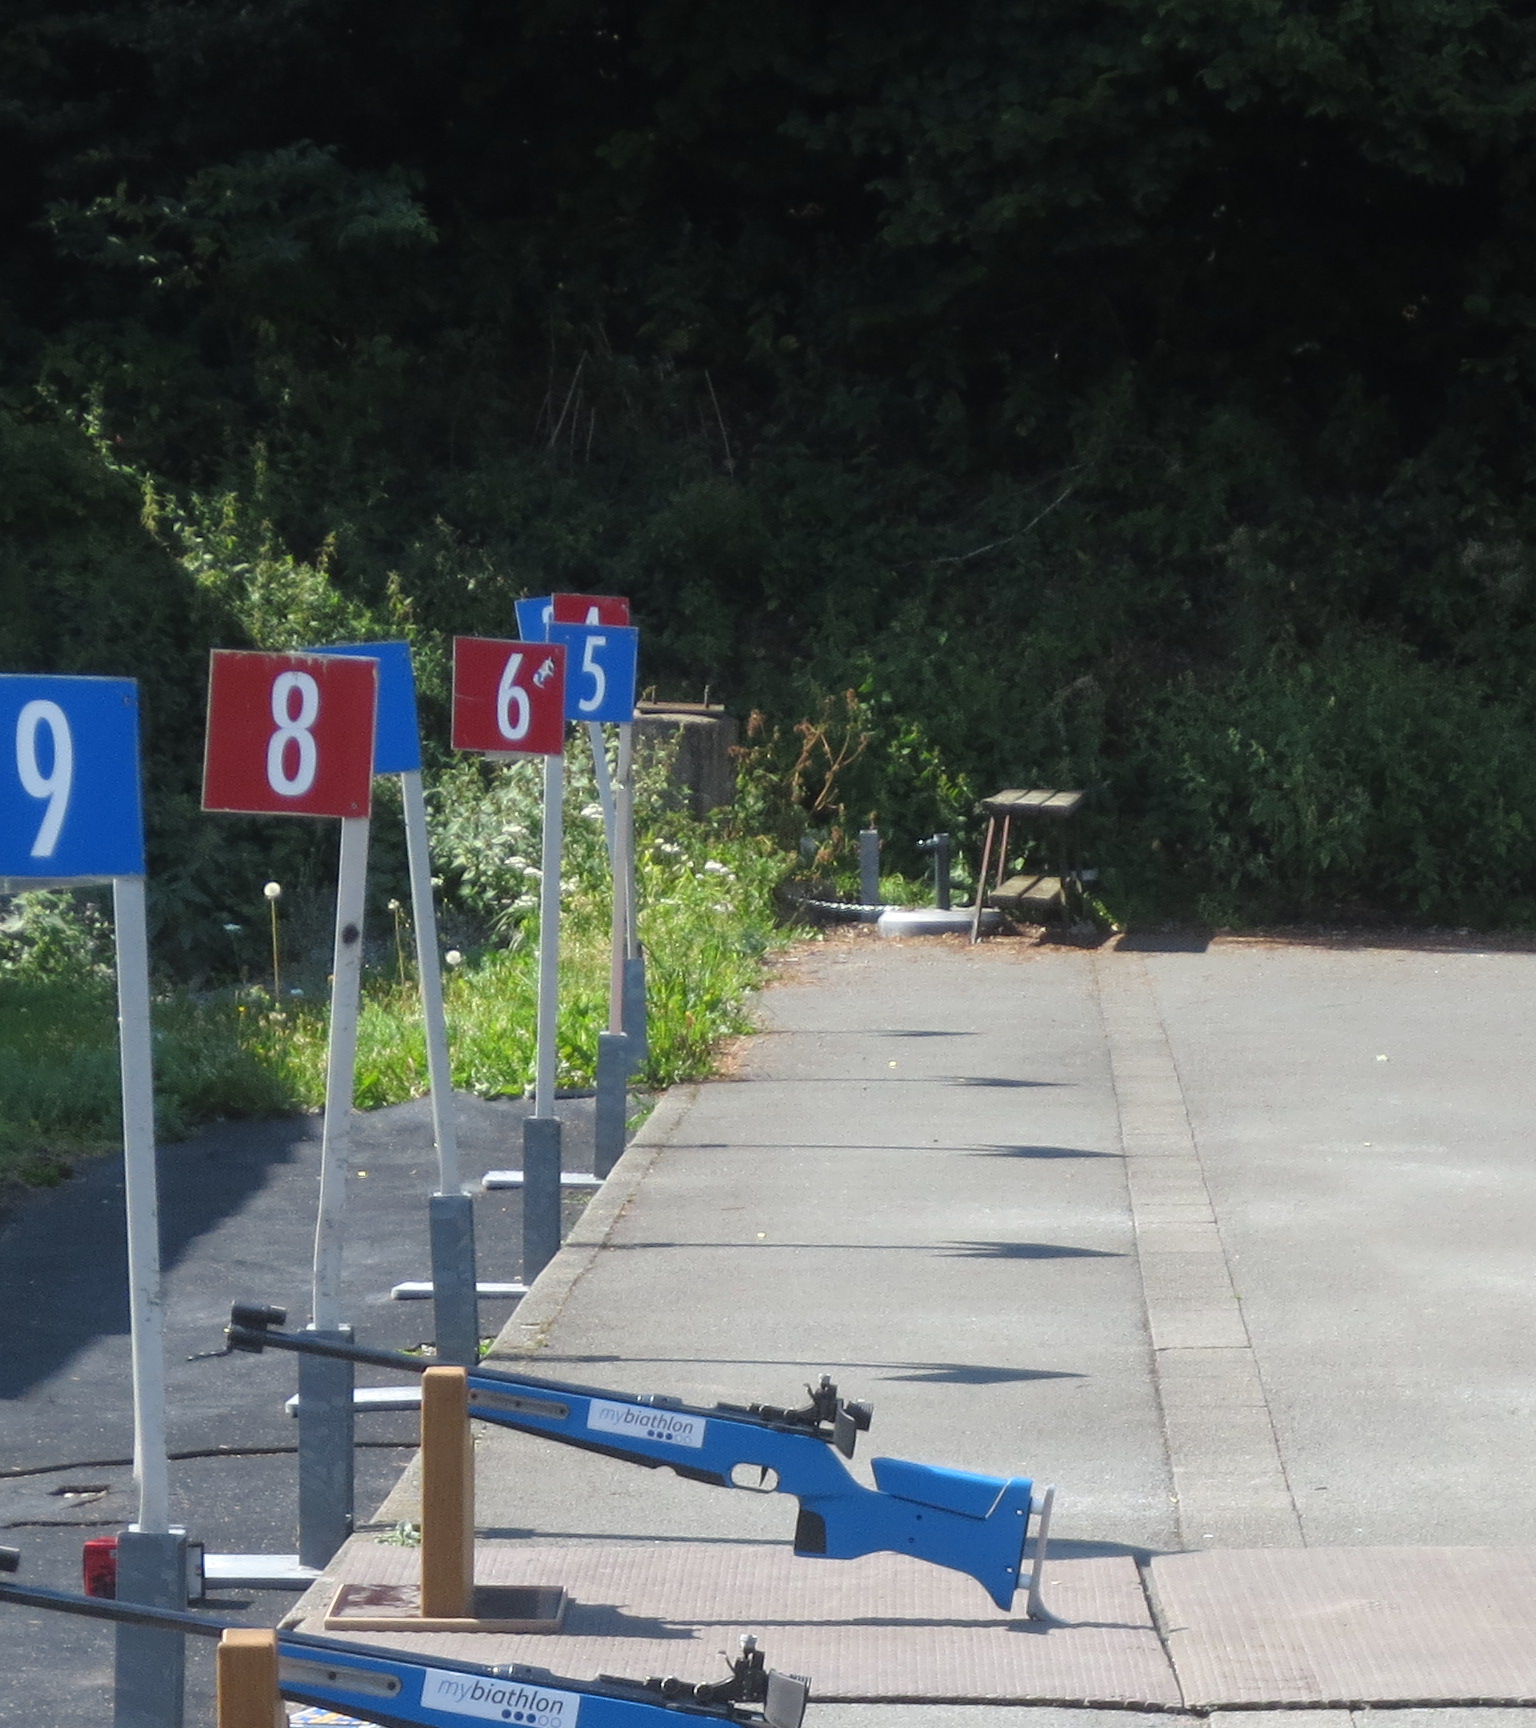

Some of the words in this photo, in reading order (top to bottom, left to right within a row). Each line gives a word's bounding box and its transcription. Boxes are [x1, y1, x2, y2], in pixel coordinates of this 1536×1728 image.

[497, 652, 530, 740] 6
[579, 635, 606, 712] 5
[267, 670, 319, 796] 8
[16, 699, 73, 858] 9
[599, 1407, 694, 1435] mybiathlon
[437, 1679, 565, 1716] mybiathlon
